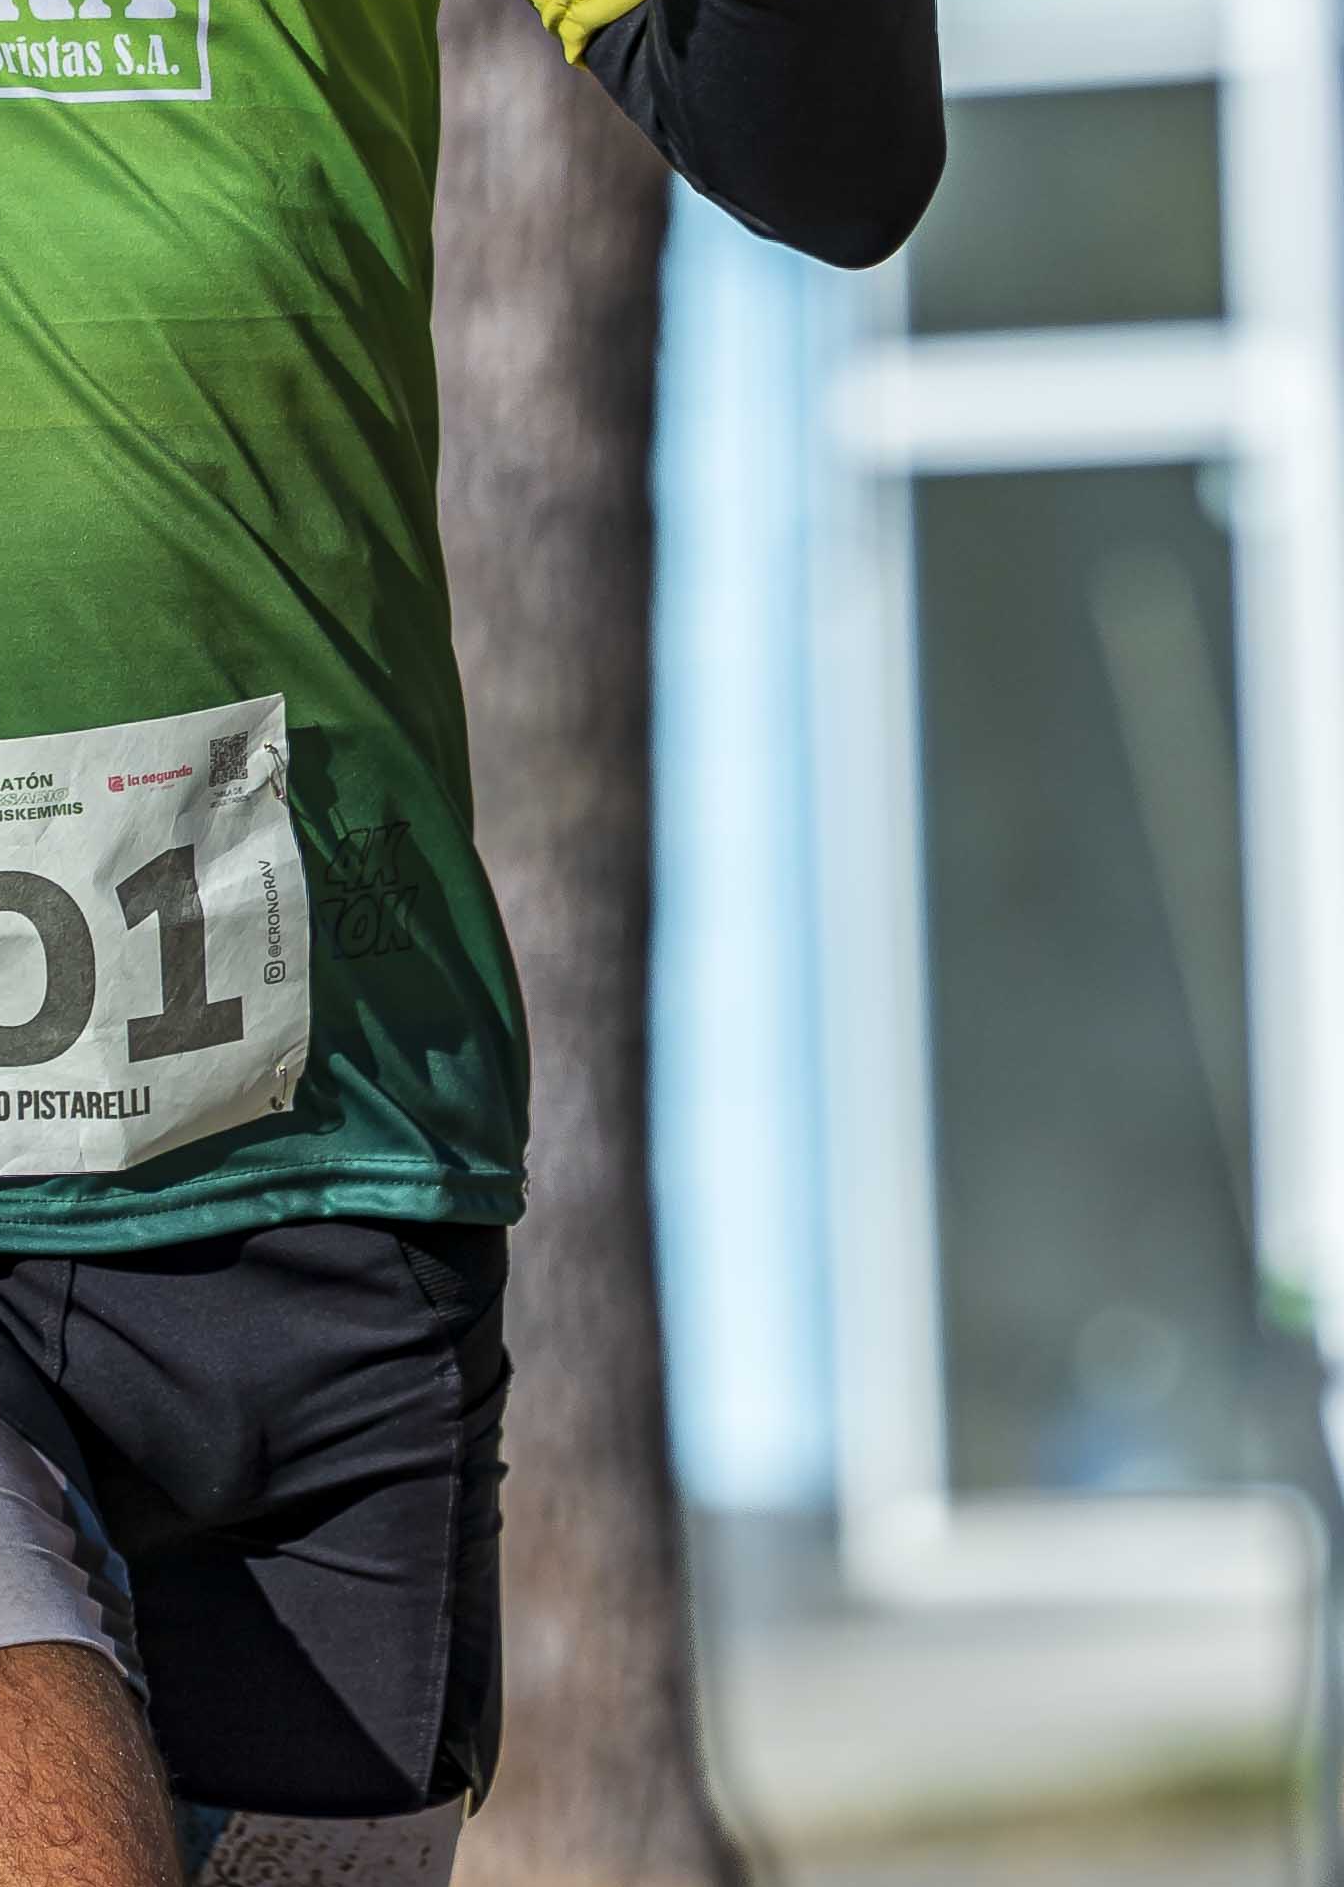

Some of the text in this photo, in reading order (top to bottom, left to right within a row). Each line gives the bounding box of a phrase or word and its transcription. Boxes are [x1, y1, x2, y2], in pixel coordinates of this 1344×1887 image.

[116, 36, 180, 77] S.A.
[127, 765, 193, 786] la segunda
[258, 860, 282, 958] @CRONORAV
[17, 1085, 150, 1120] PISTARELLI
